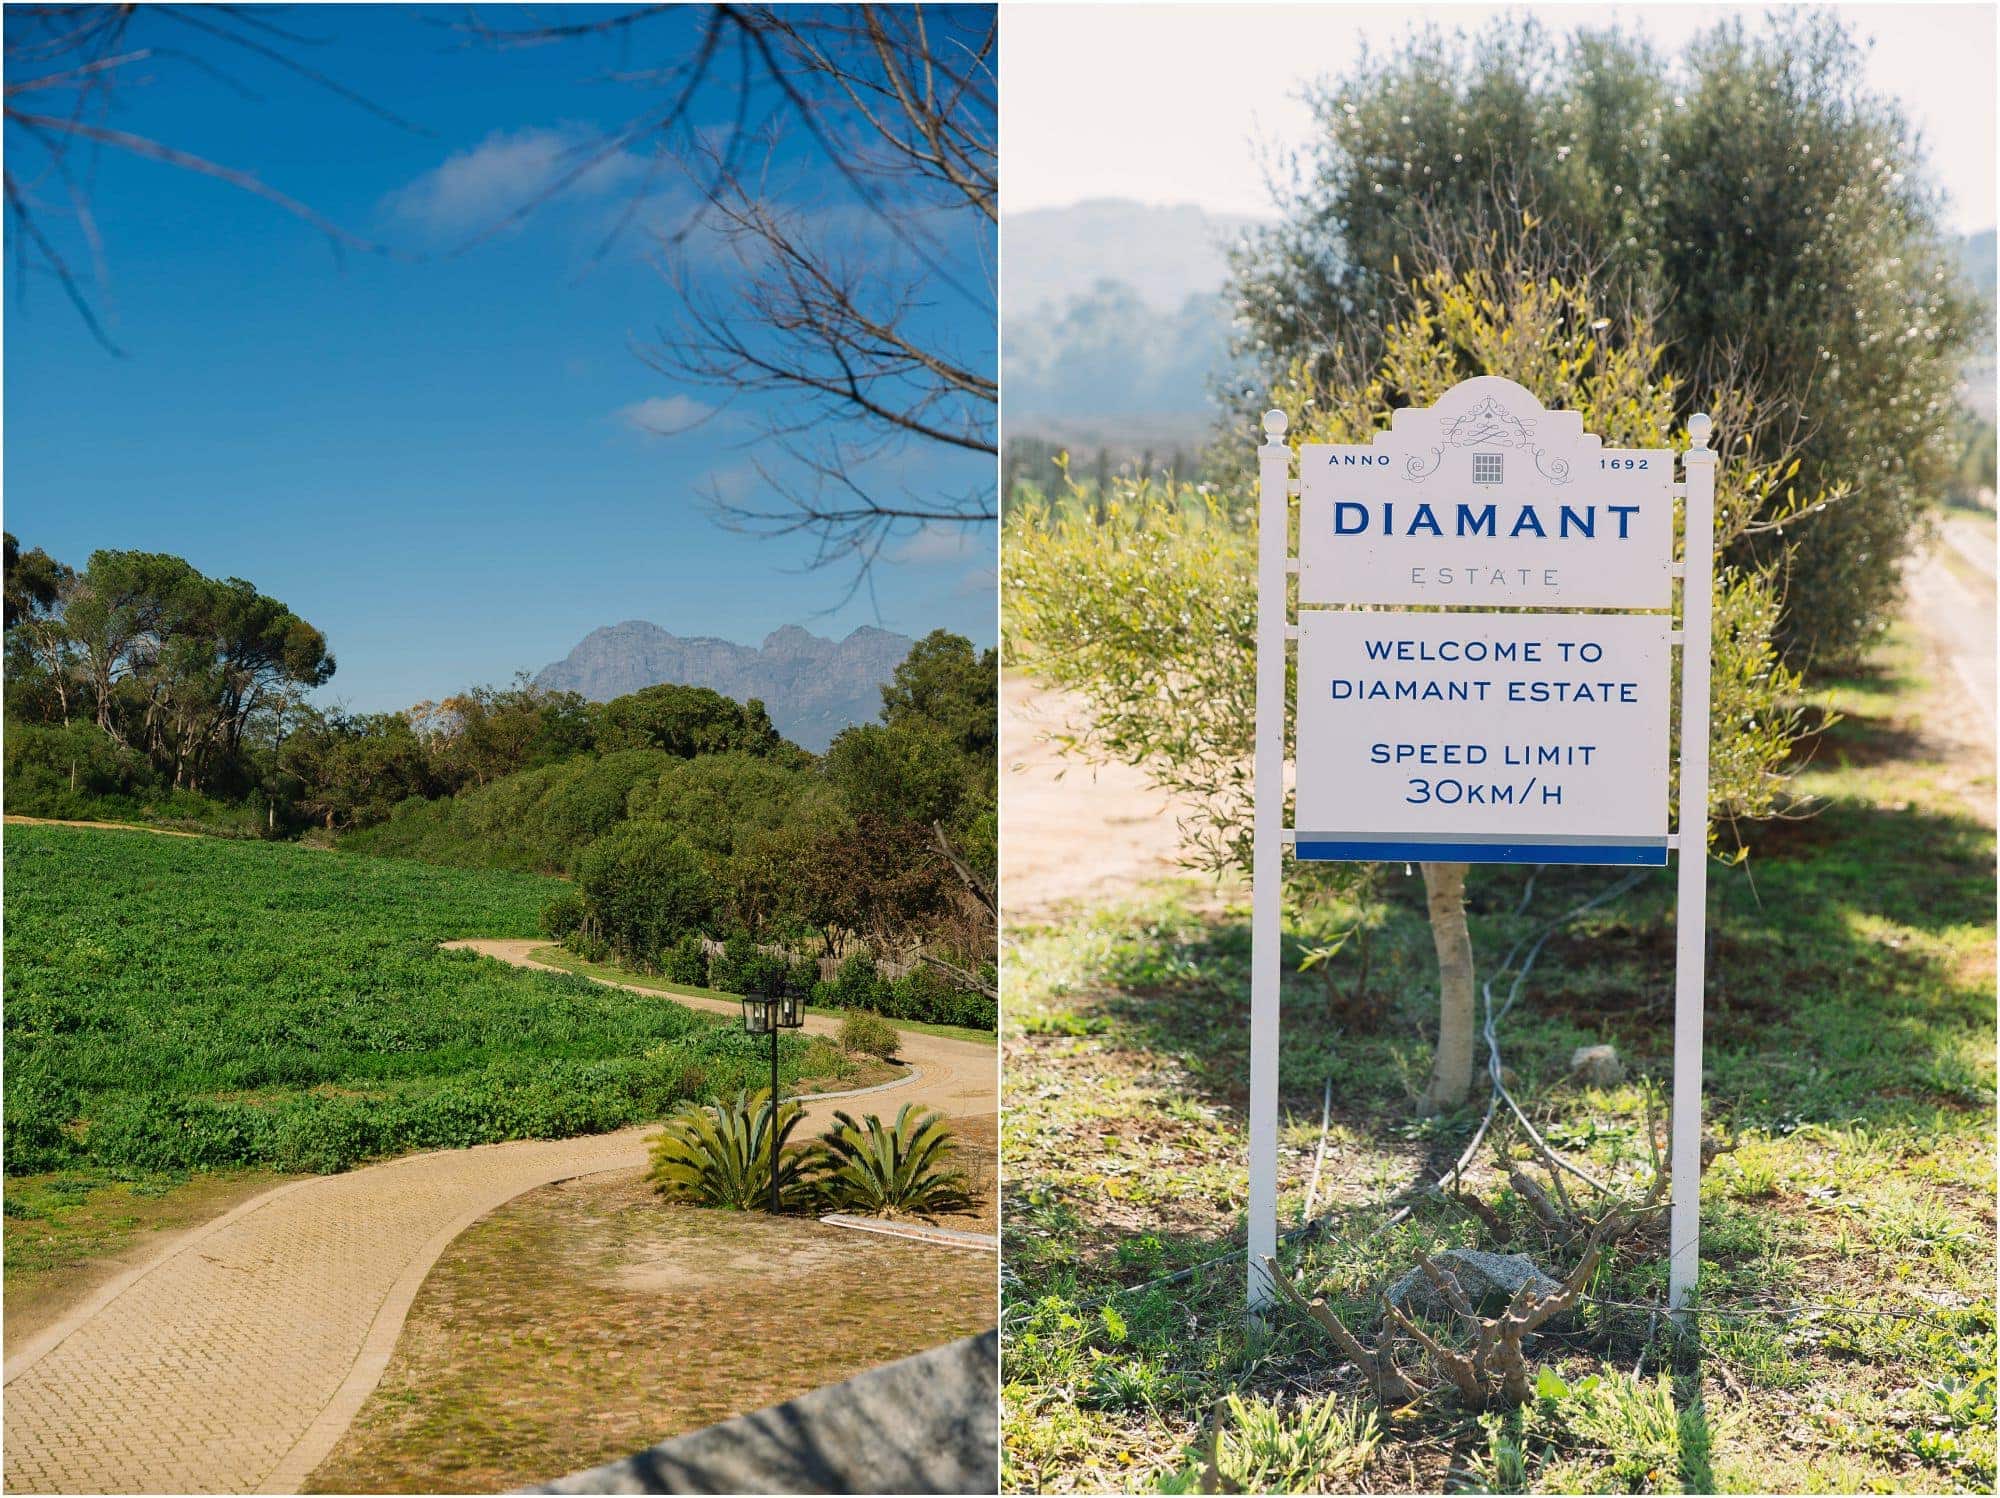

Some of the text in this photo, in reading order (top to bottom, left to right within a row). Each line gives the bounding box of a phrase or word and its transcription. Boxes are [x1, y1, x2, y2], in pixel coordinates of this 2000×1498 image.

[1329, 455, 1390, 466] ANNO
[1600, 458, 1649, 470] 1692
[1333, 502, 1641, 540] DIAMANT
[1411, 567, 1559, 586] ESTATE
[1365, 640, 1603, 663] WELCOME TO
[1331, 680, 1638, 703] DIAMANT ESTATE
[1370, 743, 1597, 766] SPEED LIMIT
[1405, 777, 1562, 805] 30KM/H
